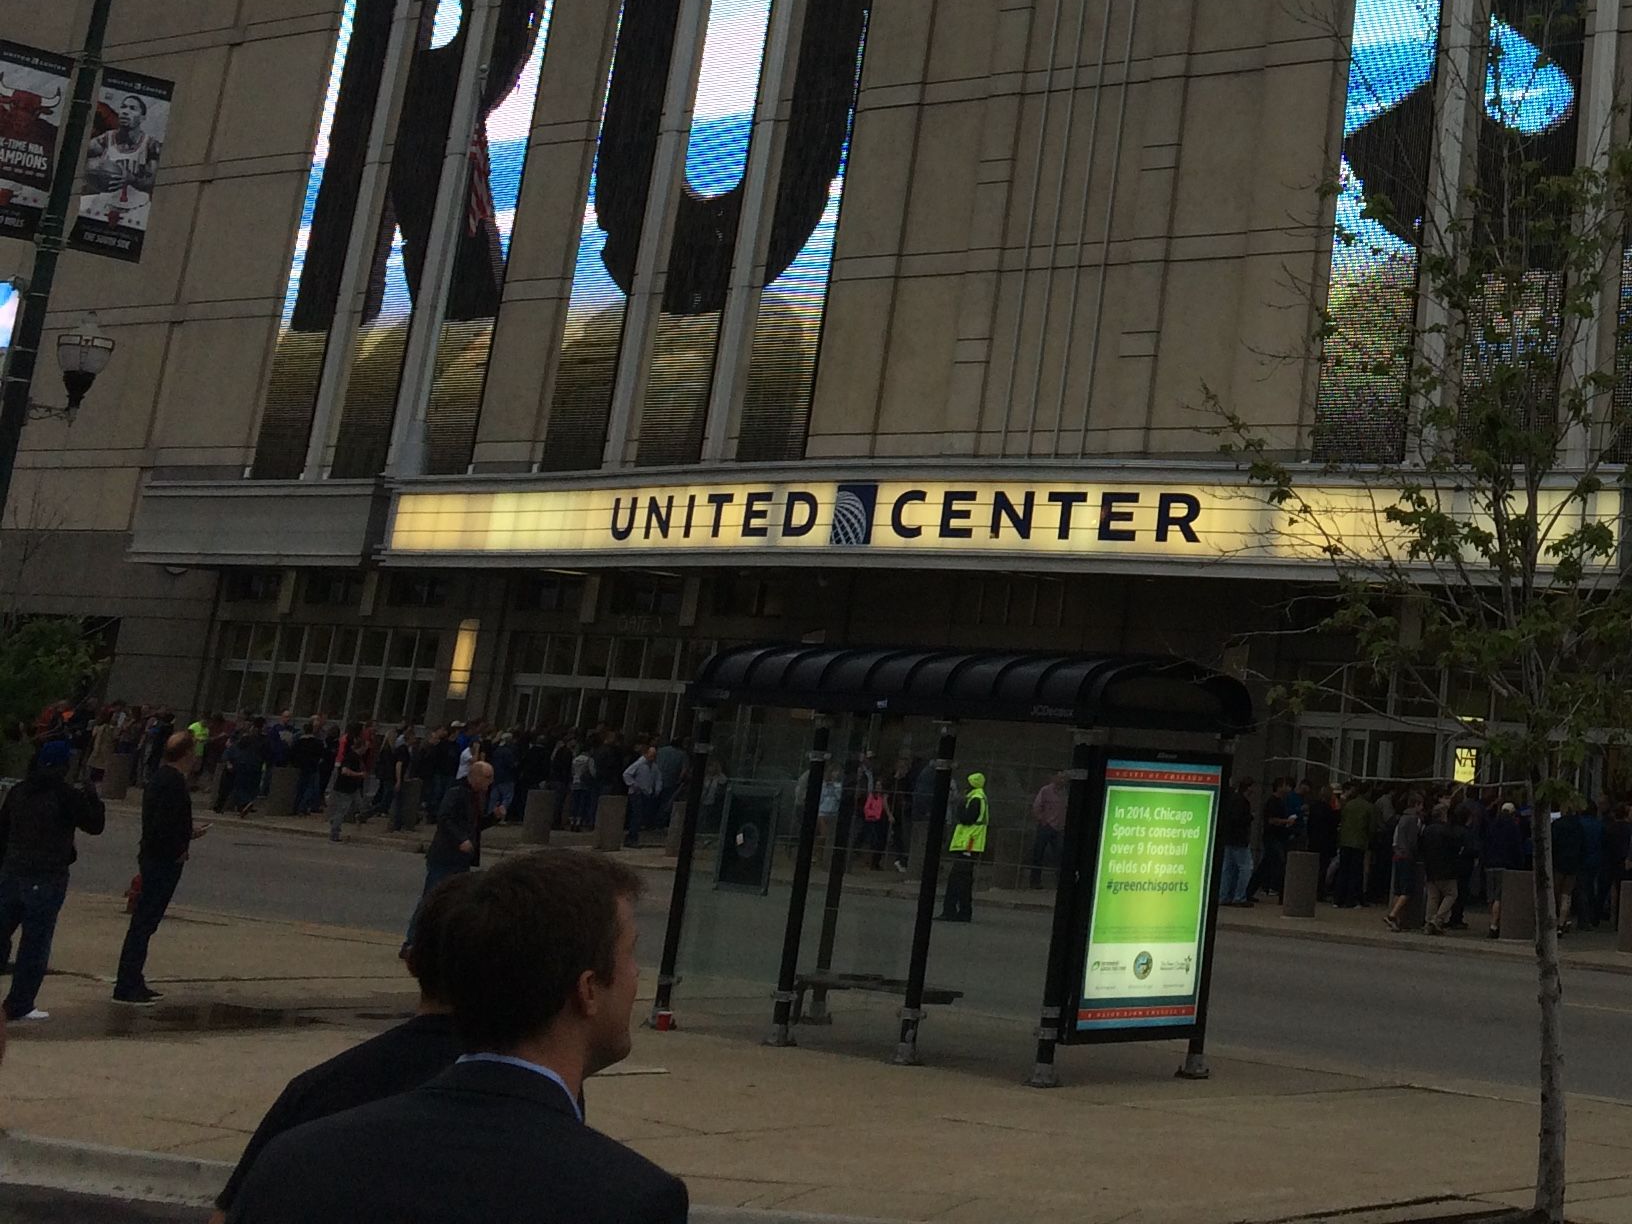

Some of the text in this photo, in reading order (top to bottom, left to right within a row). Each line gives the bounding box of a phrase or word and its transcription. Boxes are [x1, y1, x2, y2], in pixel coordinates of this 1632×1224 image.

[27, 142, 44, 155] NBA
[610, 487, 1202, 545] UNITED CENTER
[1115, 805, 1193, 824] In 2014, Chicago
[1112, 822, 1200, 841] Sports conserved
[1110, 841, 1188, 856] over 9 football
[1108, 859, 1187, 879] fields of space.
[1106, 877, 1189, 896] #greenchisports
